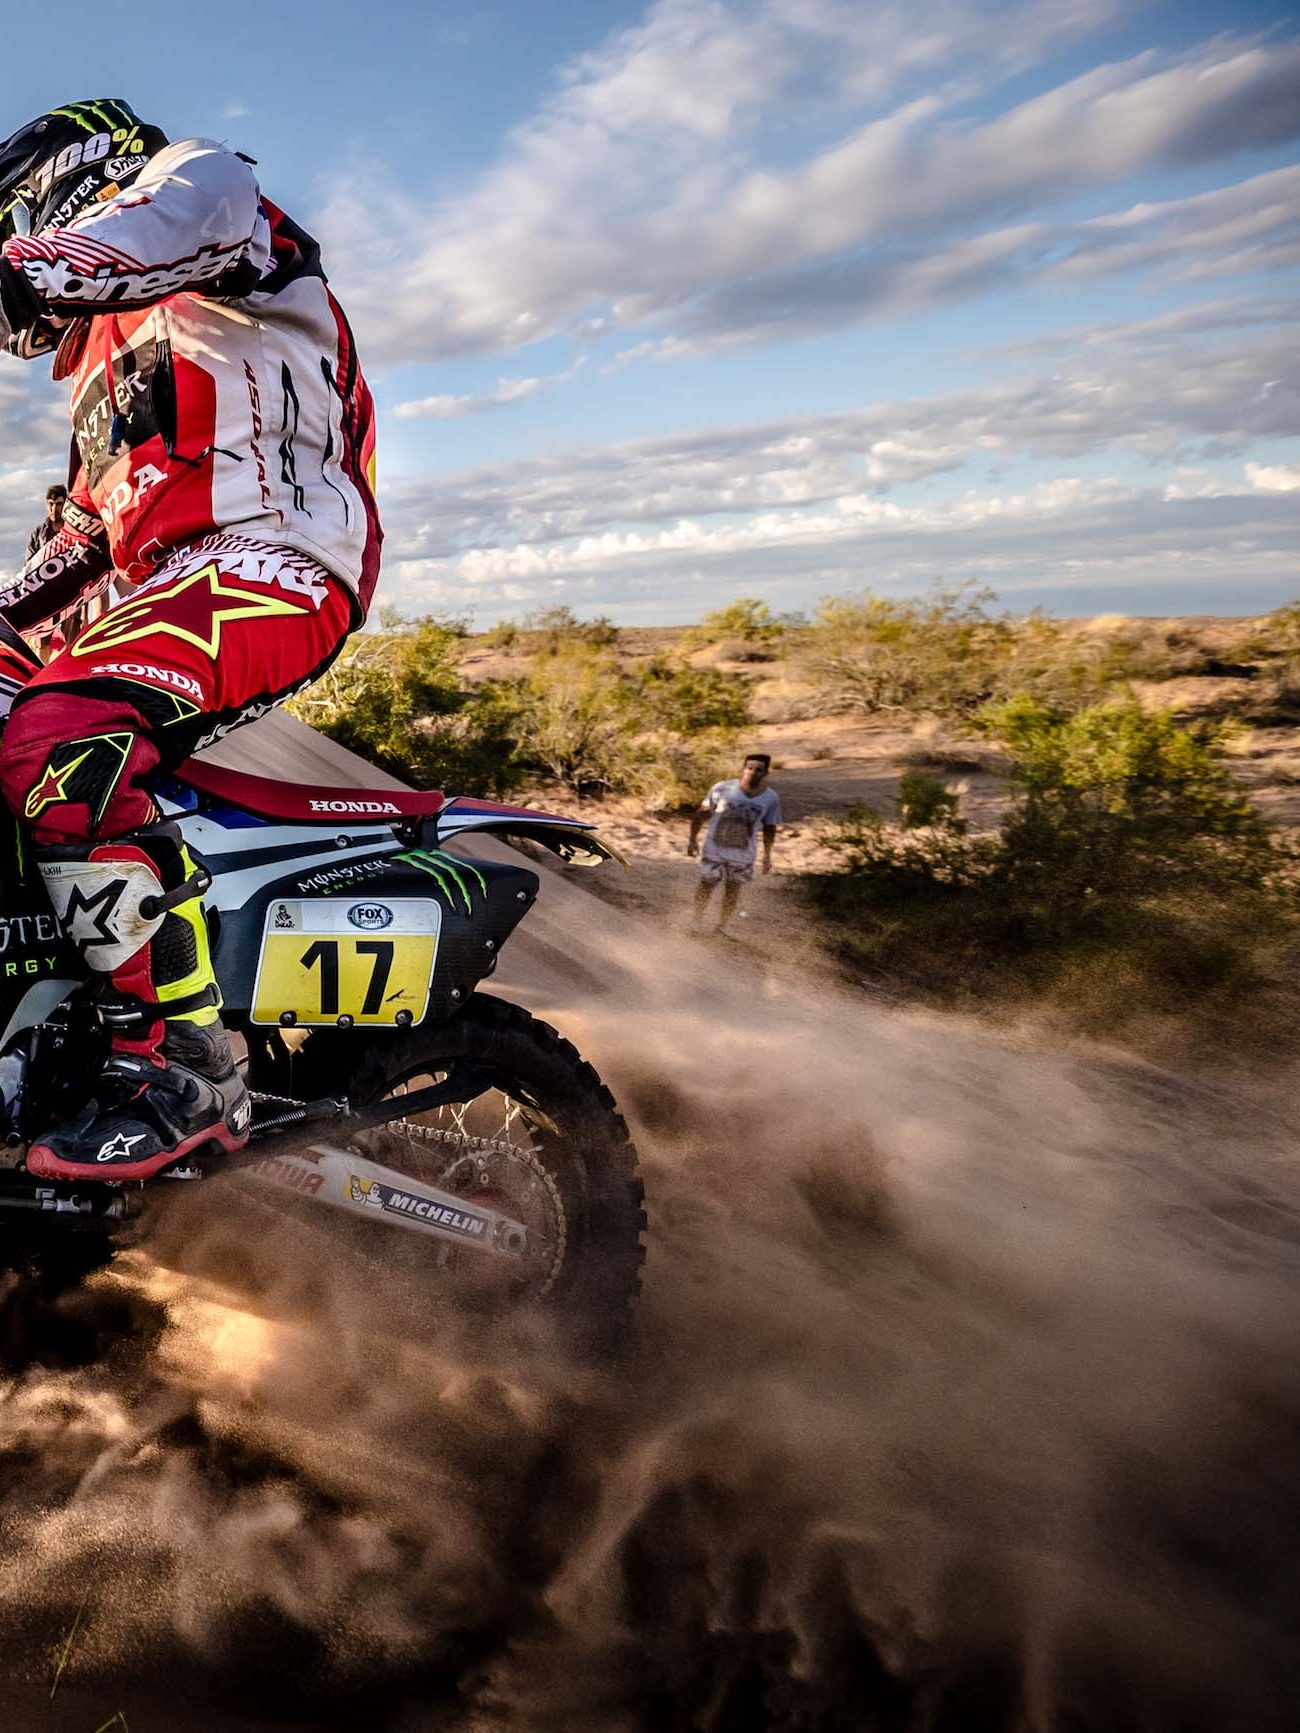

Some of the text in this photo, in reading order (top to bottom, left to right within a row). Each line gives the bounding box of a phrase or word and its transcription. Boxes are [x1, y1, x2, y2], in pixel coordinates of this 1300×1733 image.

[34, 126, 144, 198] 100%
[43, 175, 100, 230] NSTER
[22, 243, 250, 301] alpinestar
[76, 370, 148, 455] NSTER
[100, 463, 168, 525] NDA
[91, 663, 205, 701] HONDA
[310, 800, 402, 814] HONDA
[297, 858, 392, 893] MONSTER
[357, 908, 384, 919] FOX
[300, 940, 394, 1015] 17
[388, 1193, 485, 1234] MICHELIN
